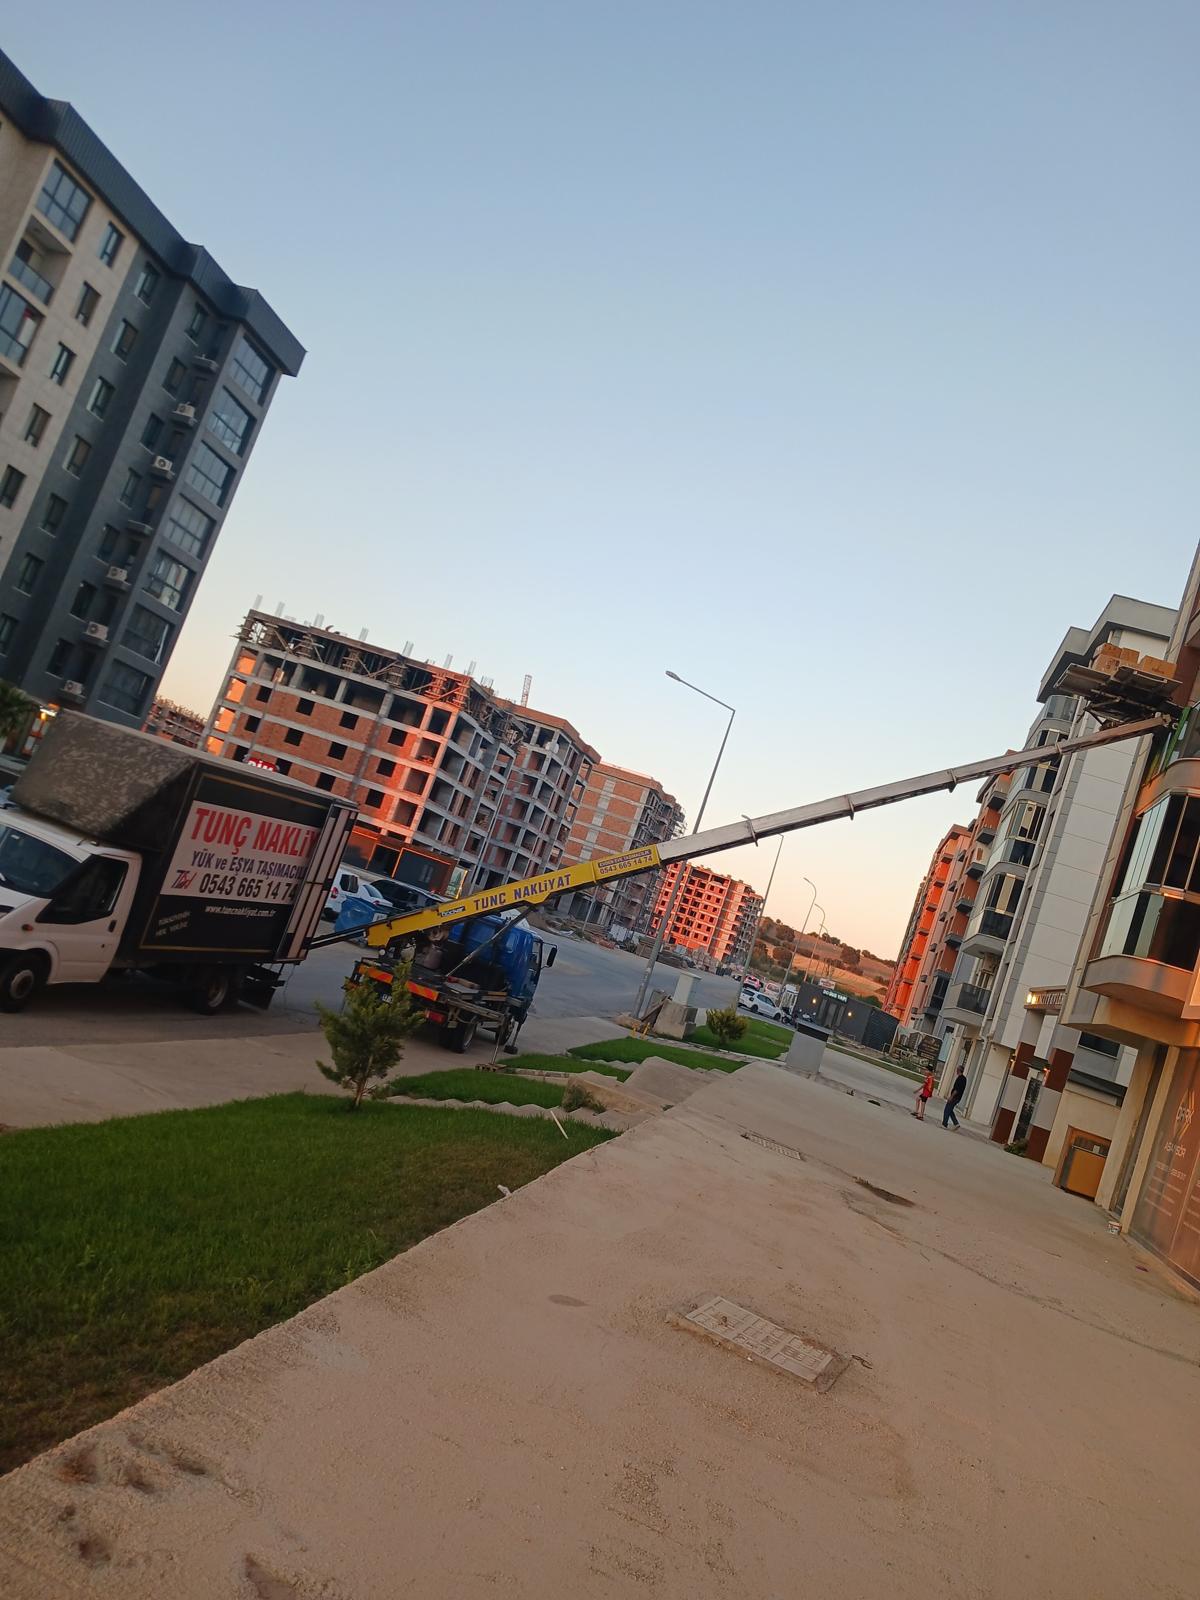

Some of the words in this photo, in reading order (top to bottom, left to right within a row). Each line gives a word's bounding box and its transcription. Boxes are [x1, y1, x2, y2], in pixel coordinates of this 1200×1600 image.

[191, 808, 252, 855] TUNÇ
[191, 848, 214, 868] YÜK
[215, 857, 228, 870] ve
[229, 857, 255, 876] EŞYA
[599, 865, 617, 875] 0543
[618, 860, 632, 870] 665
[633, 858, 642, 866] 14
[644, 855, 653, 863] 74
[199, 873, 236, 896] 0543
[237, 877, 264, 898] 665
[265, 880, 281, 899] 14
[282, 883, 299, 901] 74
[513, 873, 571, 900] NAKLİYAT
